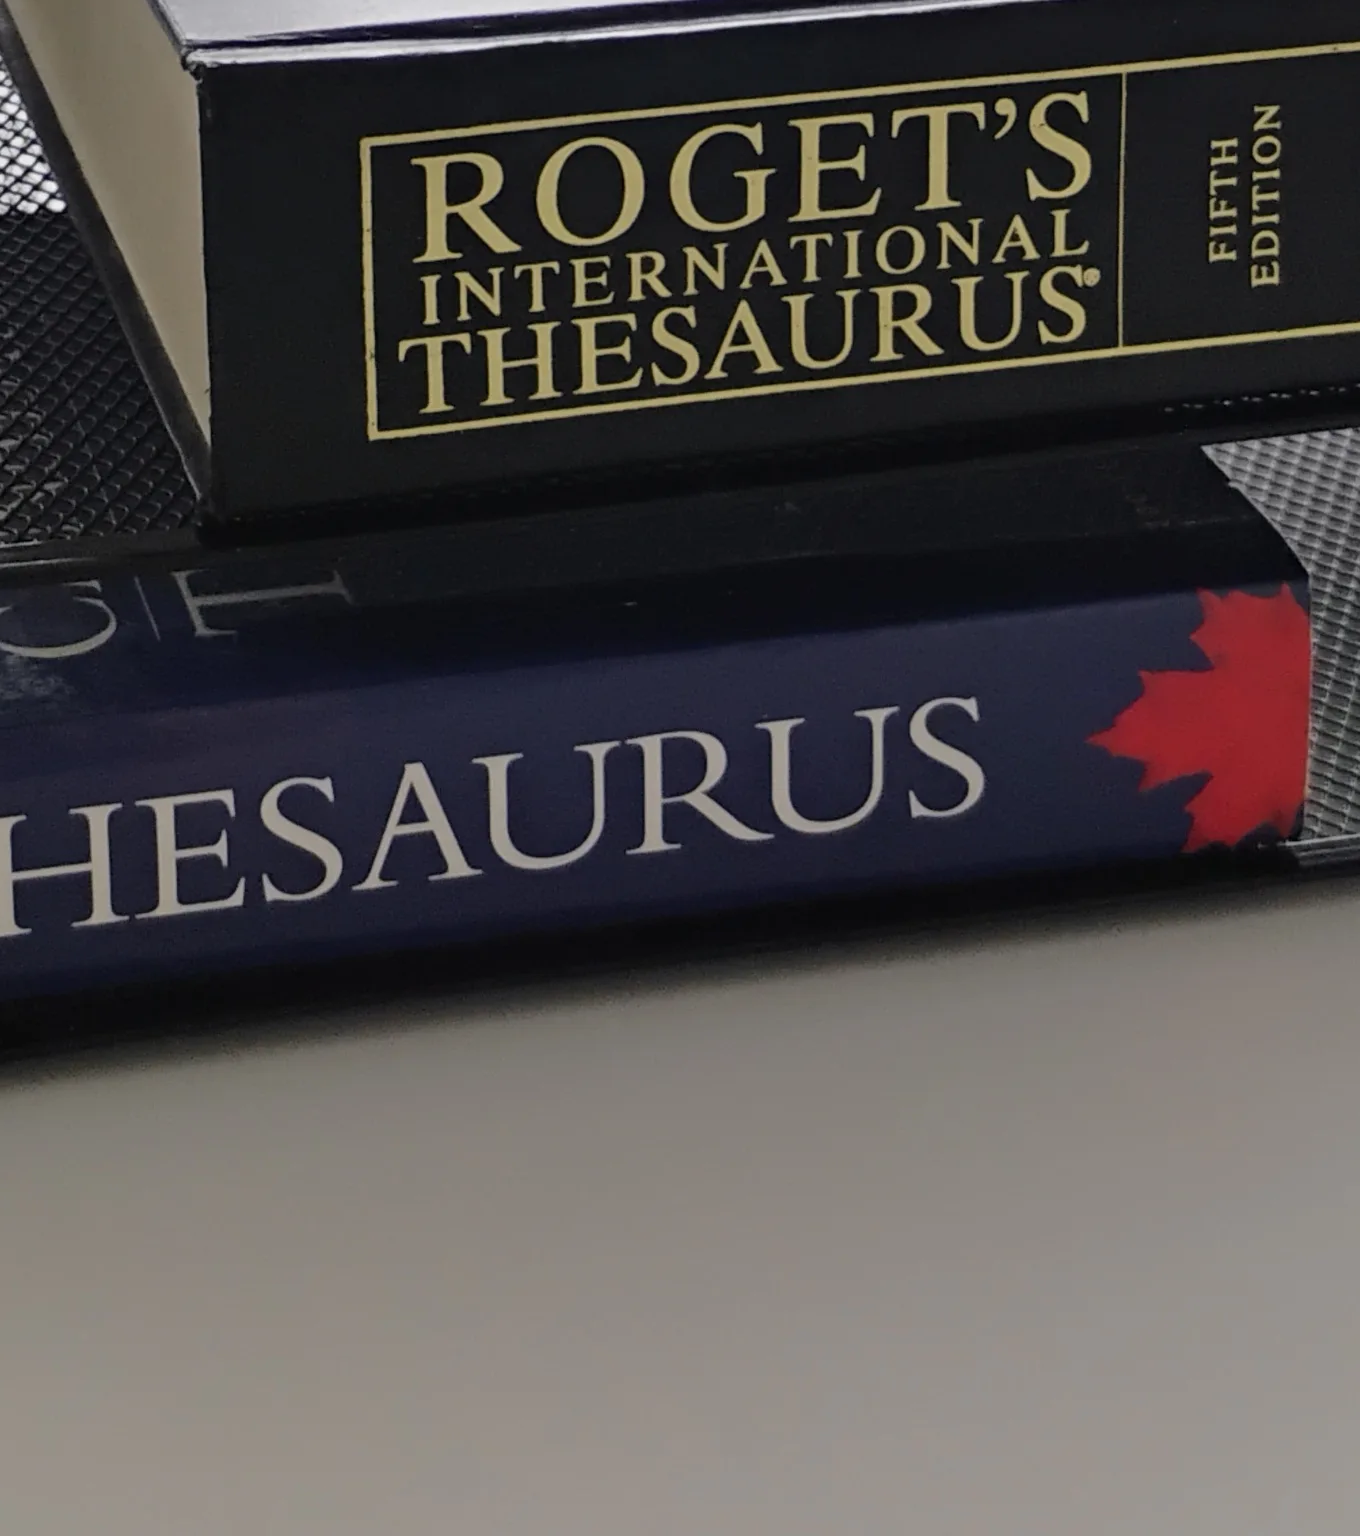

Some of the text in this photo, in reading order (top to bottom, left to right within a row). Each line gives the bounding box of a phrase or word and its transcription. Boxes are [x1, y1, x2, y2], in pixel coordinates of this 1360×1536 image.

[410, 89, 1093, 264] ROGET'S
[1208, 137, 1240, 263] FIFTH
[1250, 104, 1283, 288] EDITION
[420, 209, 1090, 326] INTERNATIONAL
